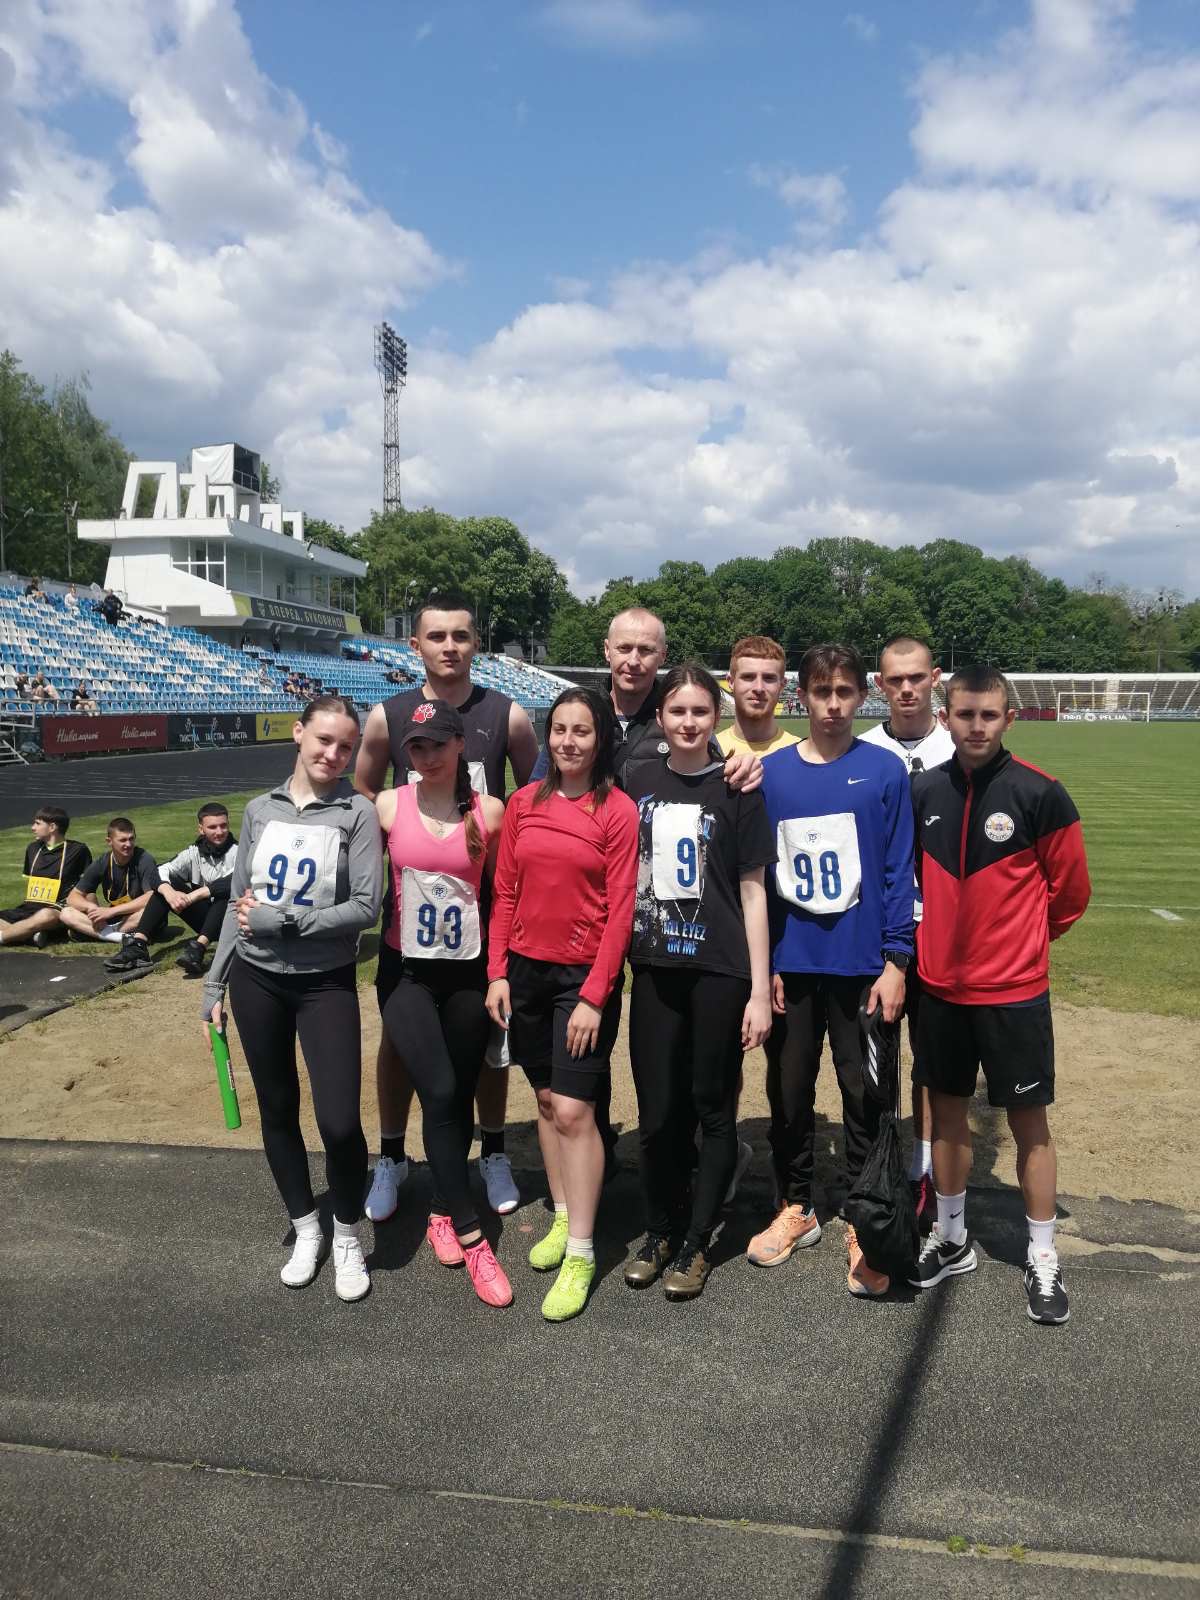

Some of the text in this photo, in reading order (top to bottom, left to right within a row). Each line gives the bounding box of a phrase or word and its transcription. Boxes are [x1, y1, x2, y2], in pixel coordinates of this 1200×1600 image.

[267, 853, 316, 906] 92
[677, 838, 697, 887] 9
[794, 851, 842, 902] 98
[417, 903, 462, 949] 93
[664, 920, 706, 941] ALL EYEZ
[667, 943, 697, 956] ON ME
